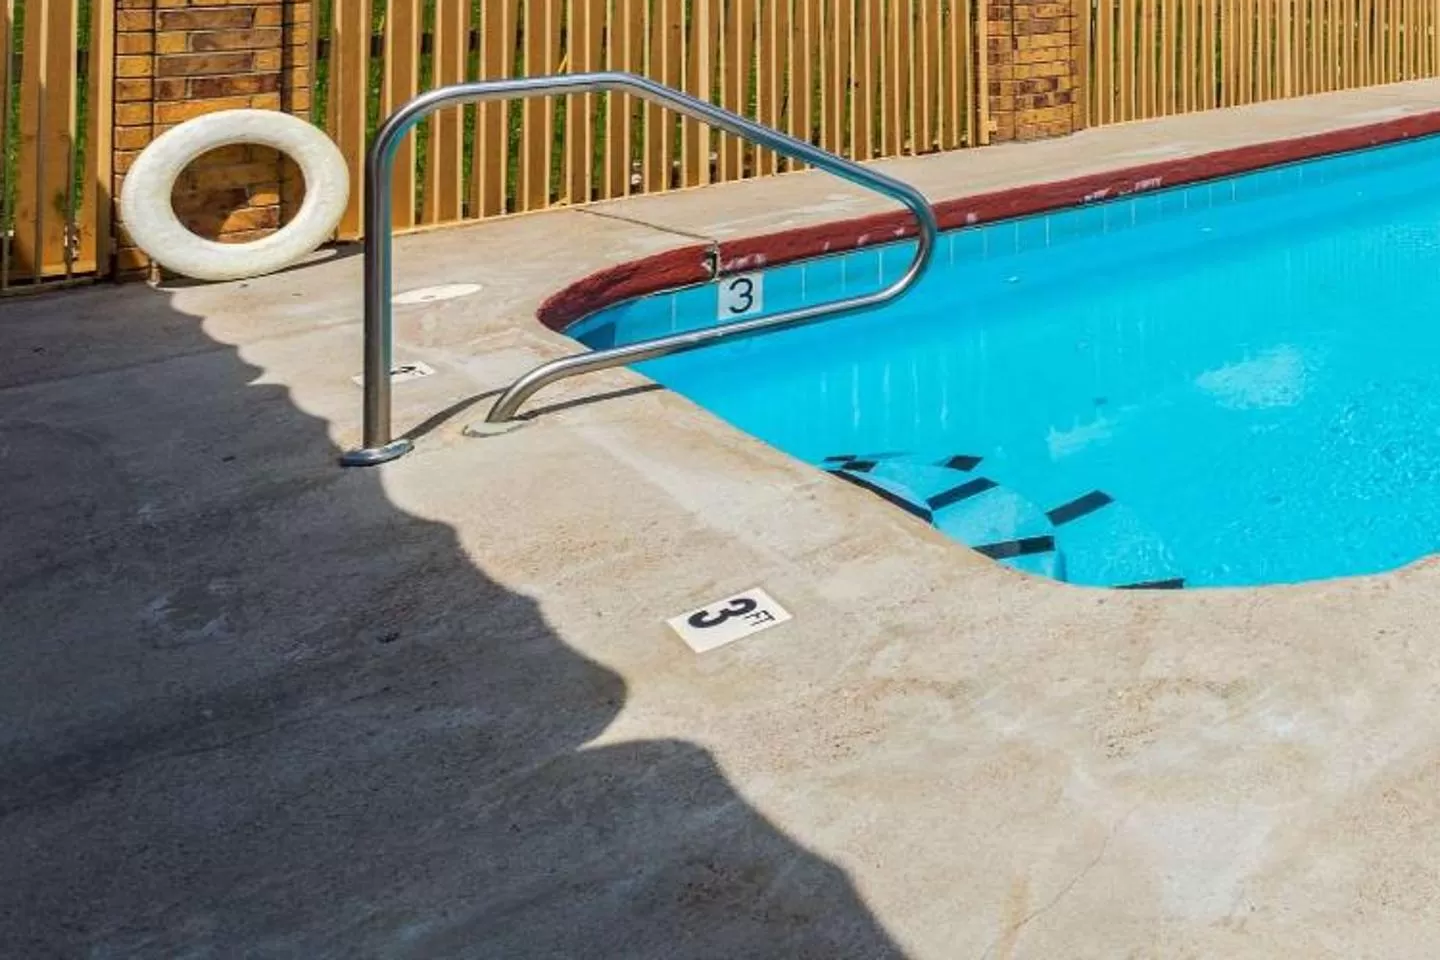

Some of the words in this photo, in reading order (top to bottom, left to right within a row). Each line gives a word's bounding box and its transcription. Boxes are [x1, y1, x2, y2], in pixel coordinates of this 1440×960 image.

[729, 278, 754, 314] 3
[687, 598, 757, 629] 3
[743, 610, 776, 627] FT
